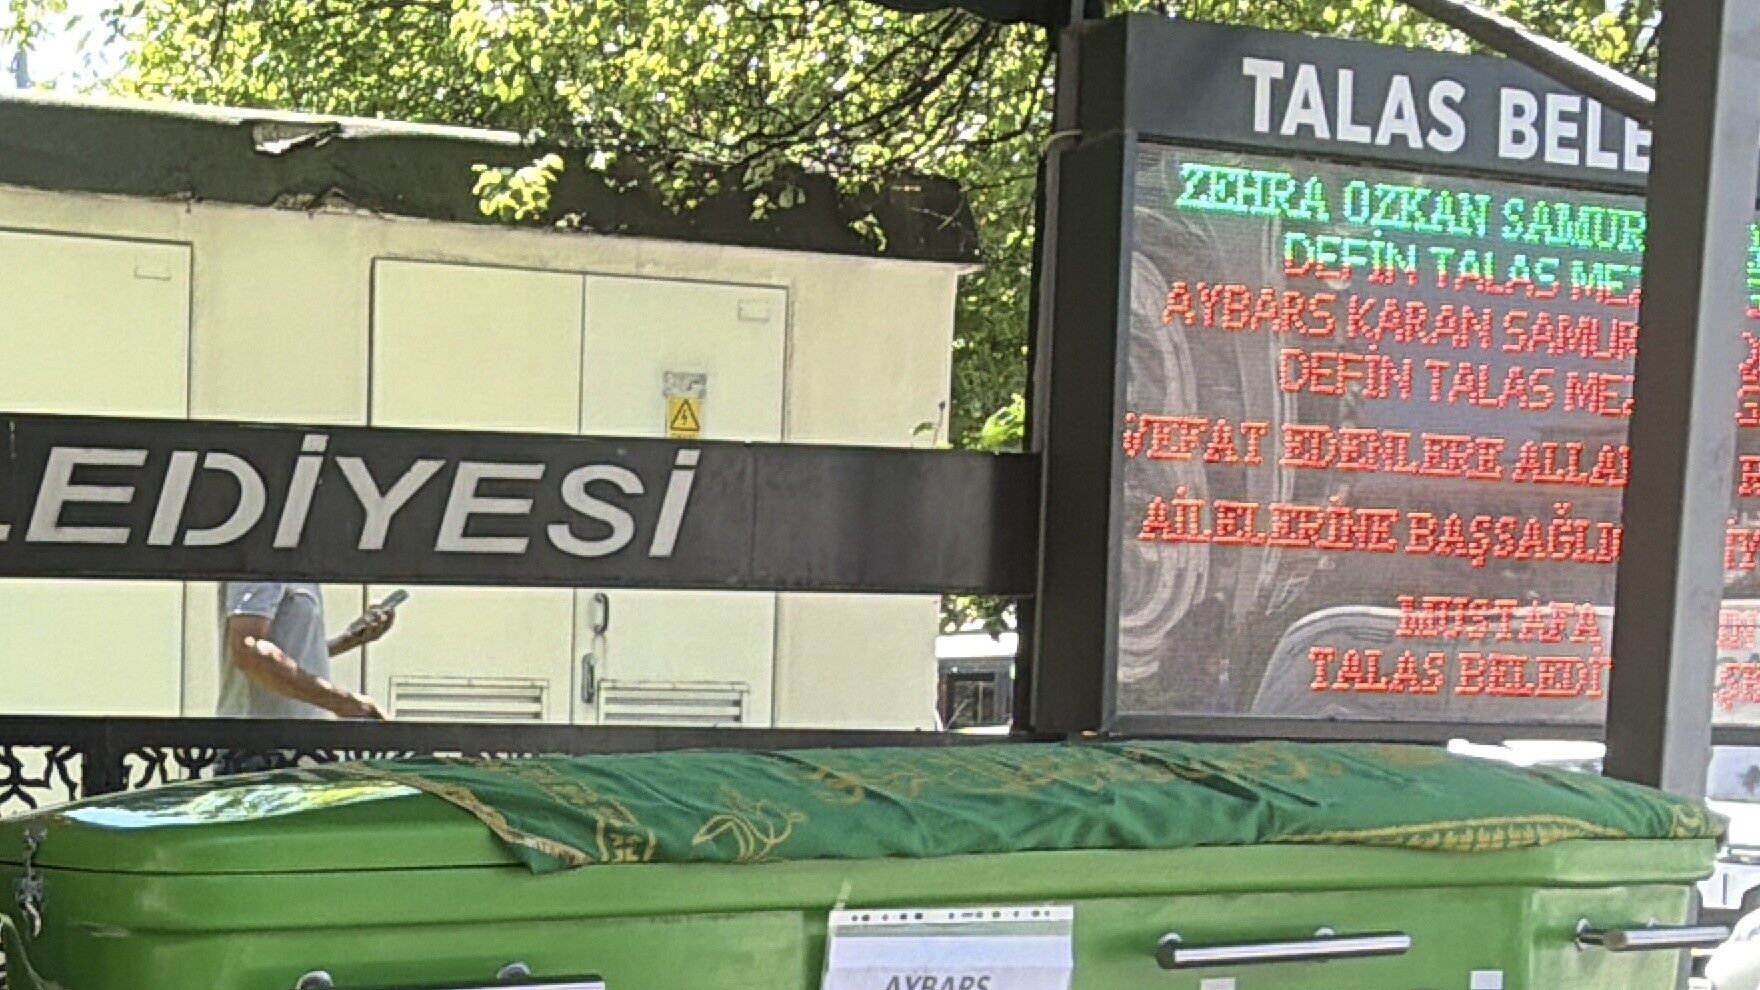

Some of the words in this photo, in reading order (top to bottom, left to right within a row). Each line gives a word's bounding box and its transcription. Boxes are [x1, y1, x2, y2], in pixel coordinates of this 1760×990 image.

[1242, 57, 1467, 152] TALAS
[1175, 162, 1331, 224] ZEHRA
[1501, 197, 1647, 254] SAMUR
[1284, 228, 1419, 287] DEFİN
[1428, 245, 1562, 300] TALAS
[1161, 281, 1338, 338] AYBARS
[1346, 294, 1493, 351] KARAN
[1501, 310, 1639, 362] SAMUR
[1280, 344, 1413, 400] DEFİN
[1424, 357, 1557, 412] TALAS
[1123, 411, 1269, 467] VEFAT
[1280, 421, 1505, 482] EDENLERE
[1138, 485, 1399, 554] AİLELERİNE
[1394, 594, 1603, 643] MUSTAFA
[1308, 646, 1446, 695] TALAS
